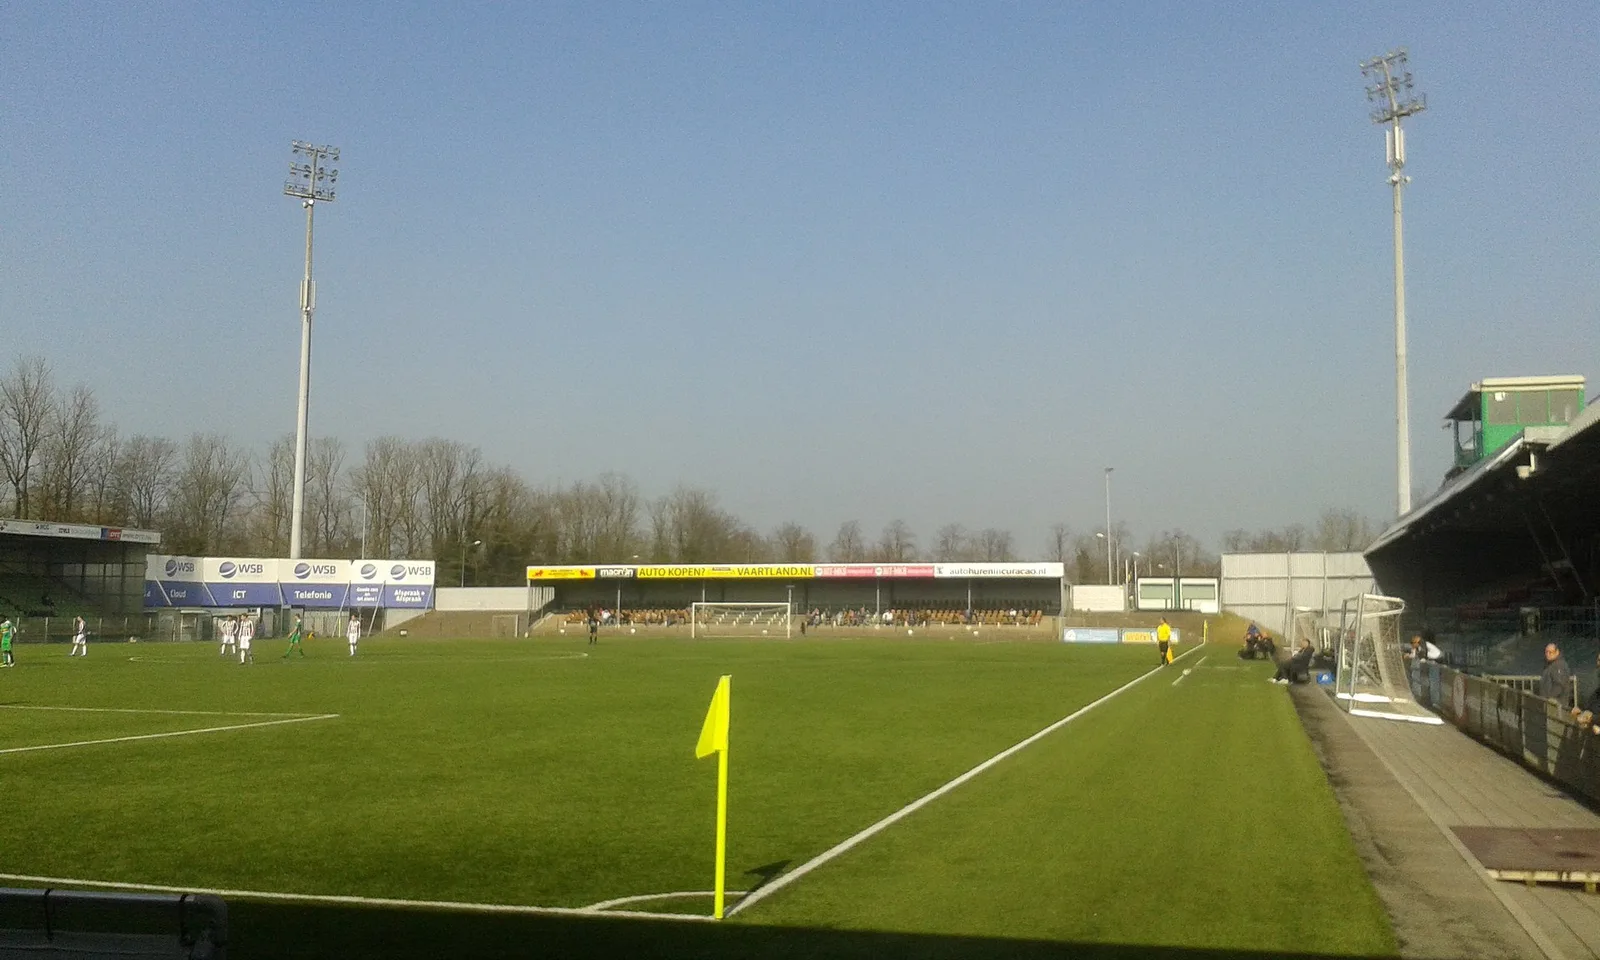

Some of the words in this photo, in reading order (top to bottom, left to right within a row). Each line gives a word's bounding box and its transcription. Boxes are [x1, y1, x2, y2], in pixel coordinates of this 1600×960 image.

[178, 562, 194, 572] WSB
[238, 563, 263, 573] WSB
[312, 565, 336, 575] WSB
[408, 566, 431, 576] WSB
[639, 567, 666, 576] AUTO
[668, 567, 705, 576] KOPEN?
[737, 567, 813, 576] VAARTLAND.NL
[170, 589, 187, 598] Cloud
[233, 590, 246, 598] ICT
[294, 590, 332, 599] Telefonie
